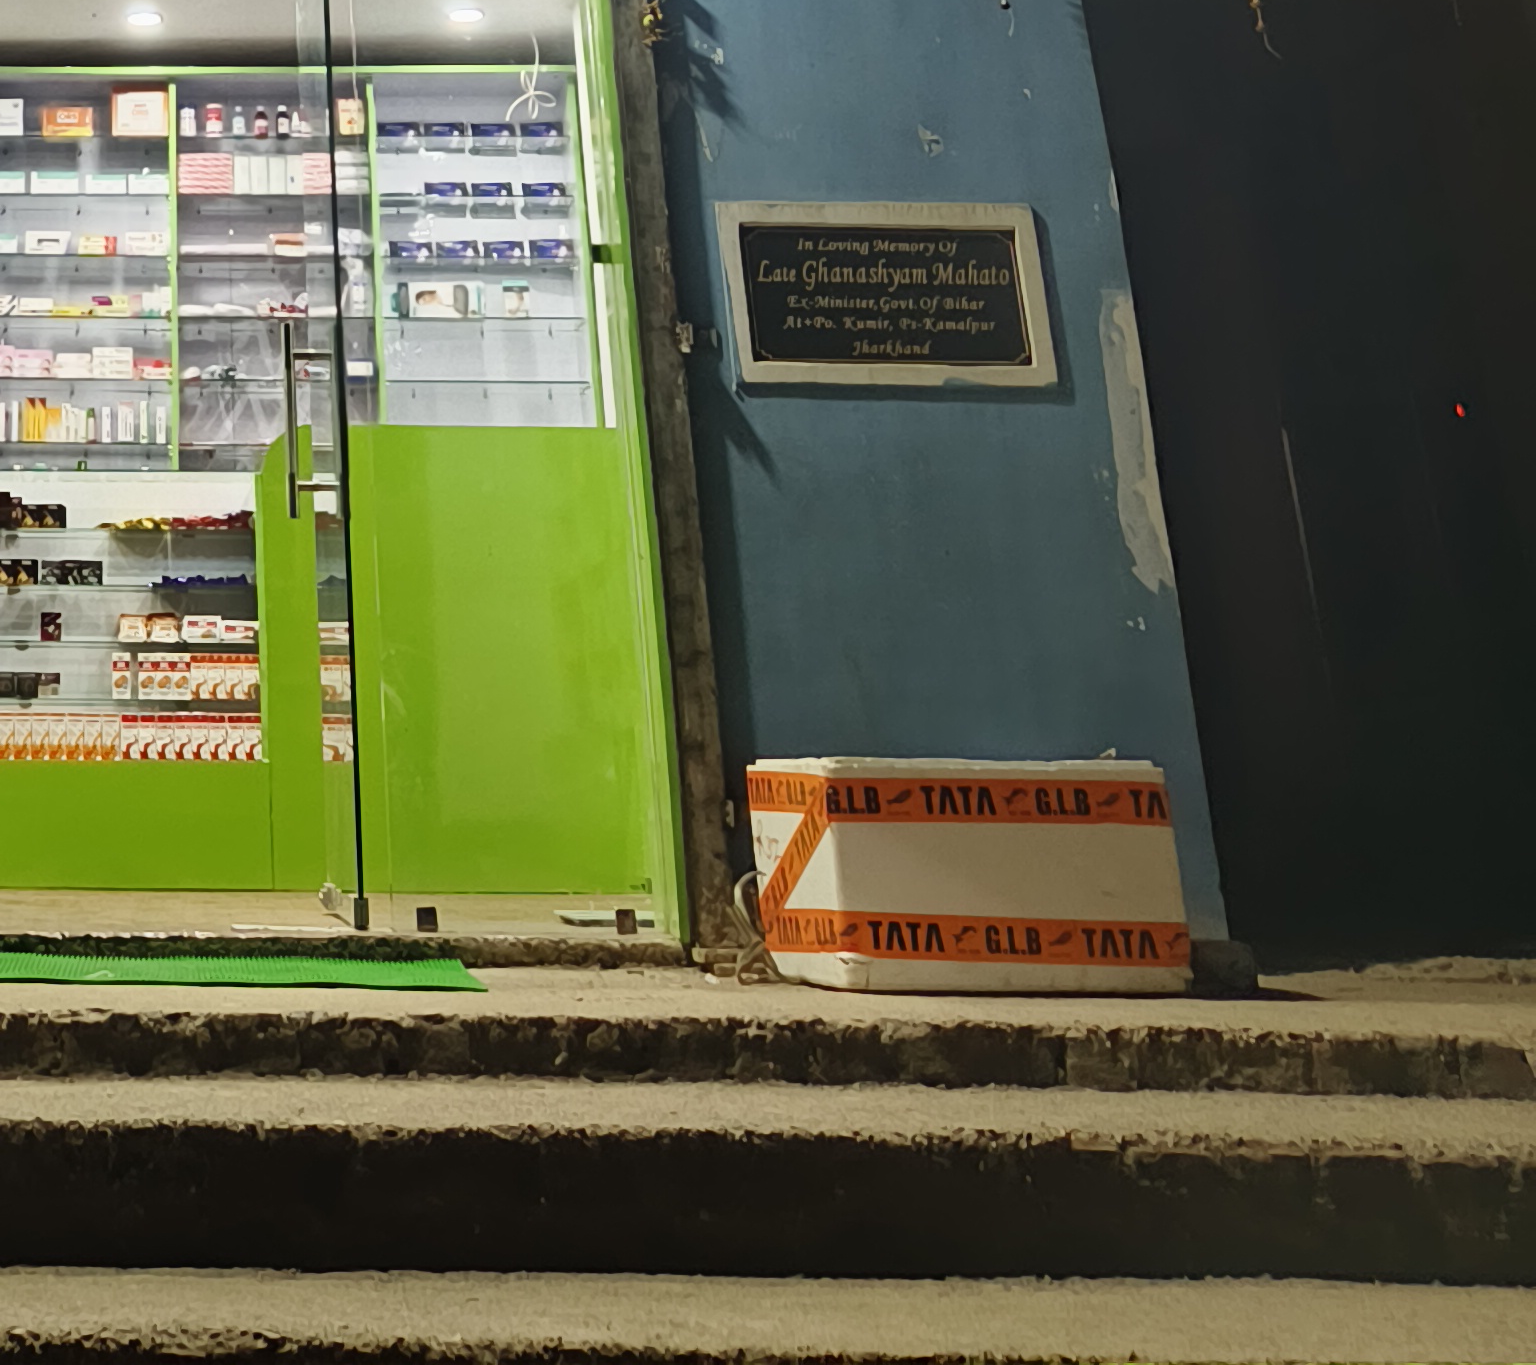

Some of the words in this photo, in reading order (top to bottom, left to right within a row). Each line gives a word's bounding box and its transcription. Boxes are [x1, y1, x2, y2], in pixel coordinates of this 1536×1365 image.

[797, 238, 814, 250] In
[817, 237, 869, 255] Loving
[873, 239, 935, 257] Memory
[938, 238, 960, 257] Of
[757, 259, 797, 282] Late
[802, 257, 928, 292] Ghanashyam
[932, 259, 1010, 285] Mahato
[919, 295, 941, 314] Of
[942, 295, 985, 310] Bihar
[852, 339, 932, 357] Jharkhand
[919, 785, 998, 816] TATA
[866, 920, 946, 953] TATA
[1081, 927, 1161, 960] TATA
